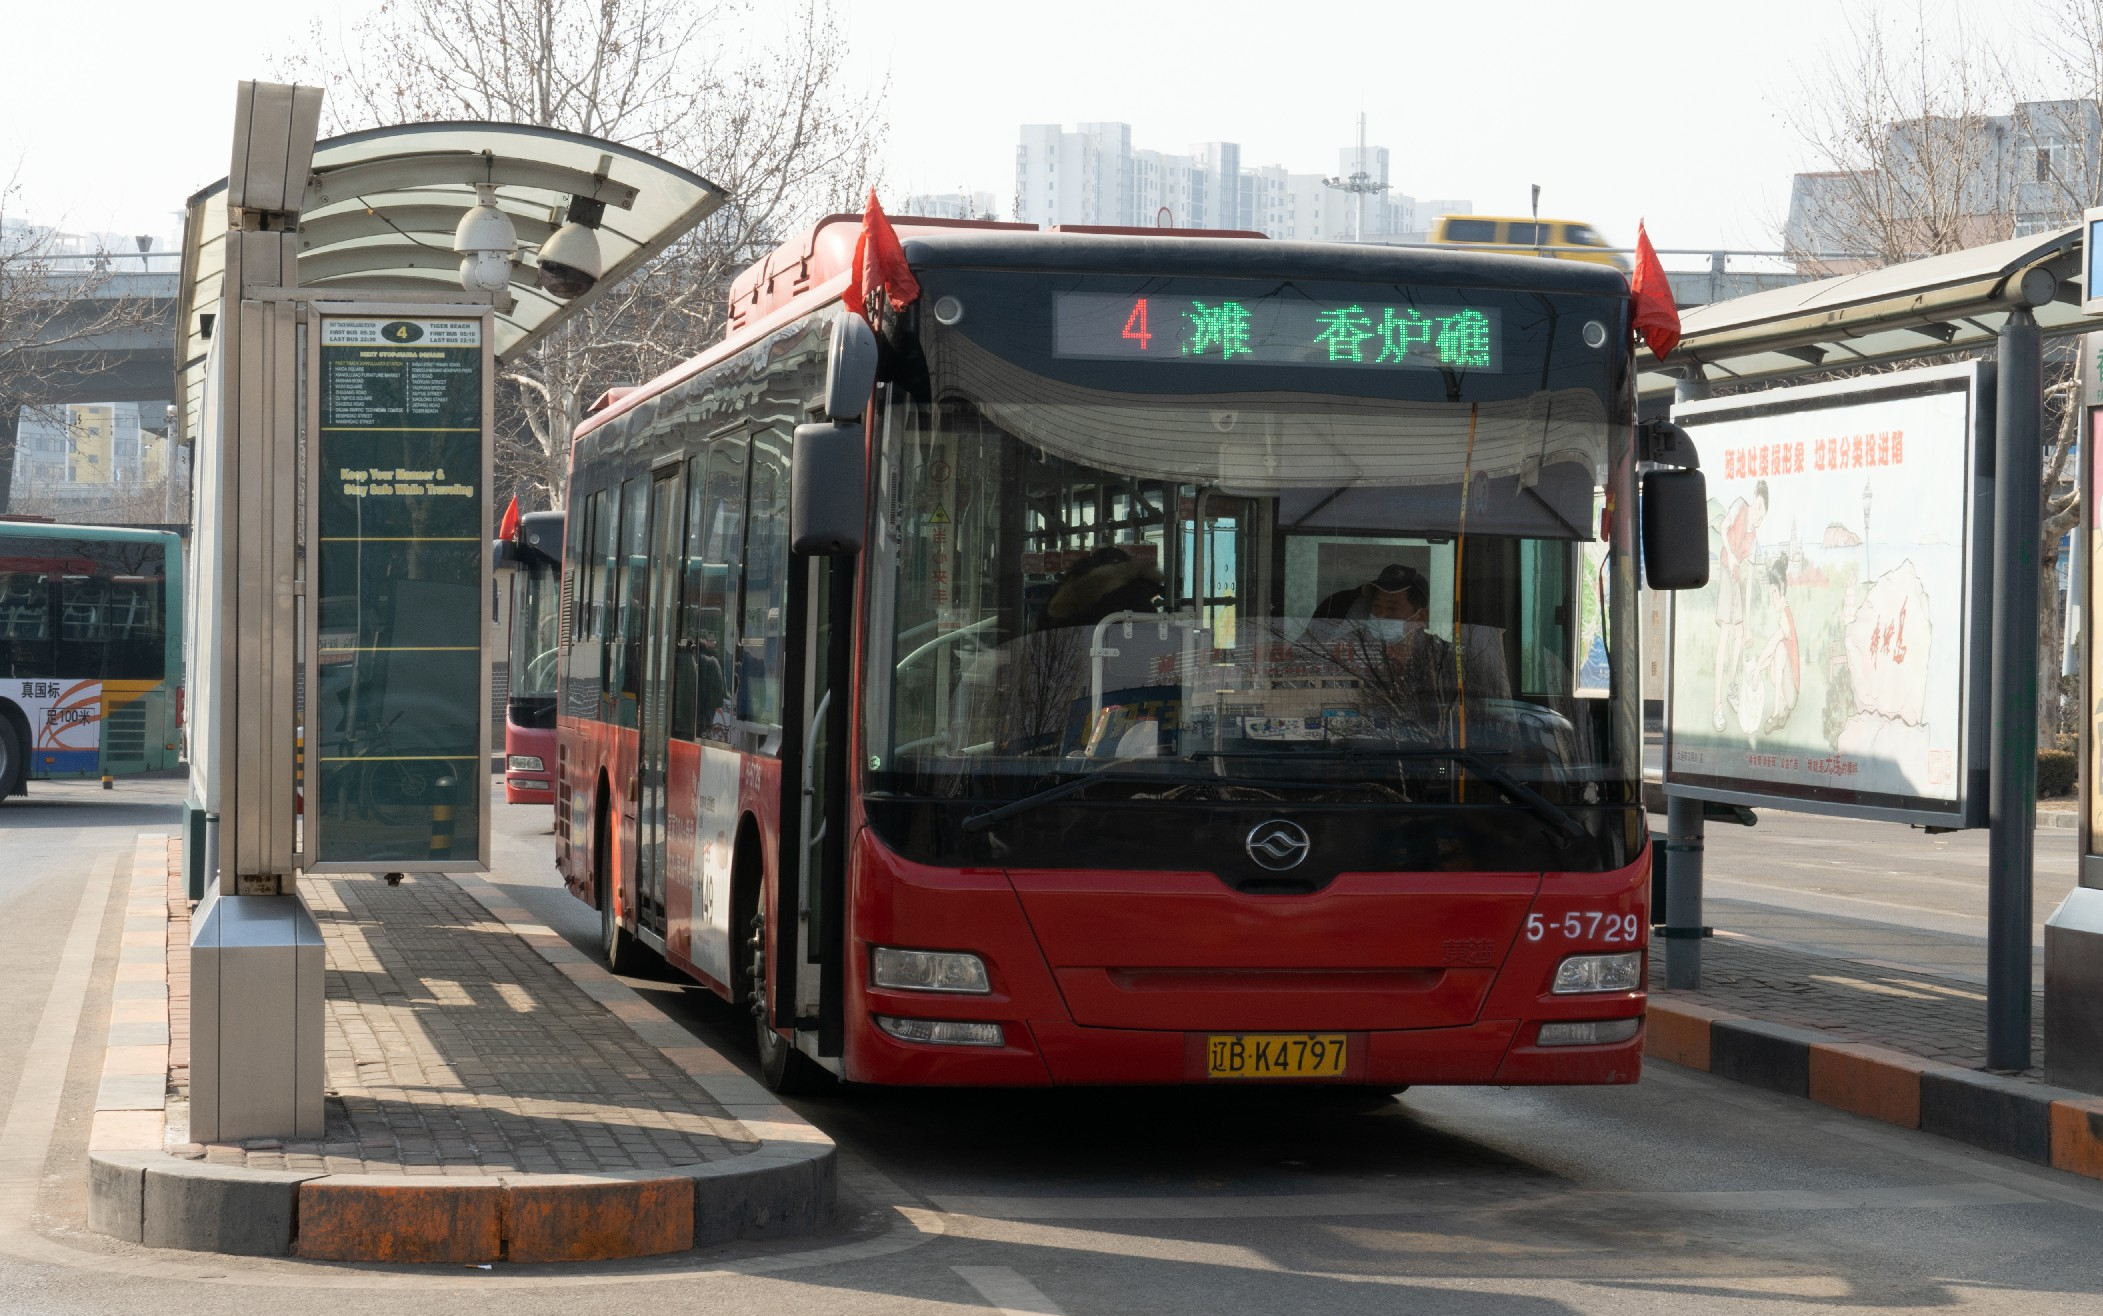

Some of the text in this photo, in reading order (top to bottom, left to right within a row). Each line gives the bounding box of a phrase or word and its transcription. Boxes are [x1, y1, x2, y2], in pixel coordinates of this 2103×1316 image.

[396, 326, 408, 339] 4
[1121, 297, 1153, 351] 4
[1313, 304, 1490, 367] 香炉礁
[340, 468, 368, 482] Keep
[370, 468, 394, 480] Your
[436, 468, 445, 480] &
[344, 484, 368, 498] Stay
[370, 484, 393, 495] Safe
[395, 484, 424, 495] While
[21, 681, 60, 699] 真国标
[46, 709, 91, 726] 足100米
[1526, 911, 1638, 942] 5-5729
[1211, 1039, 1345, 1072] 辽B·K4797
